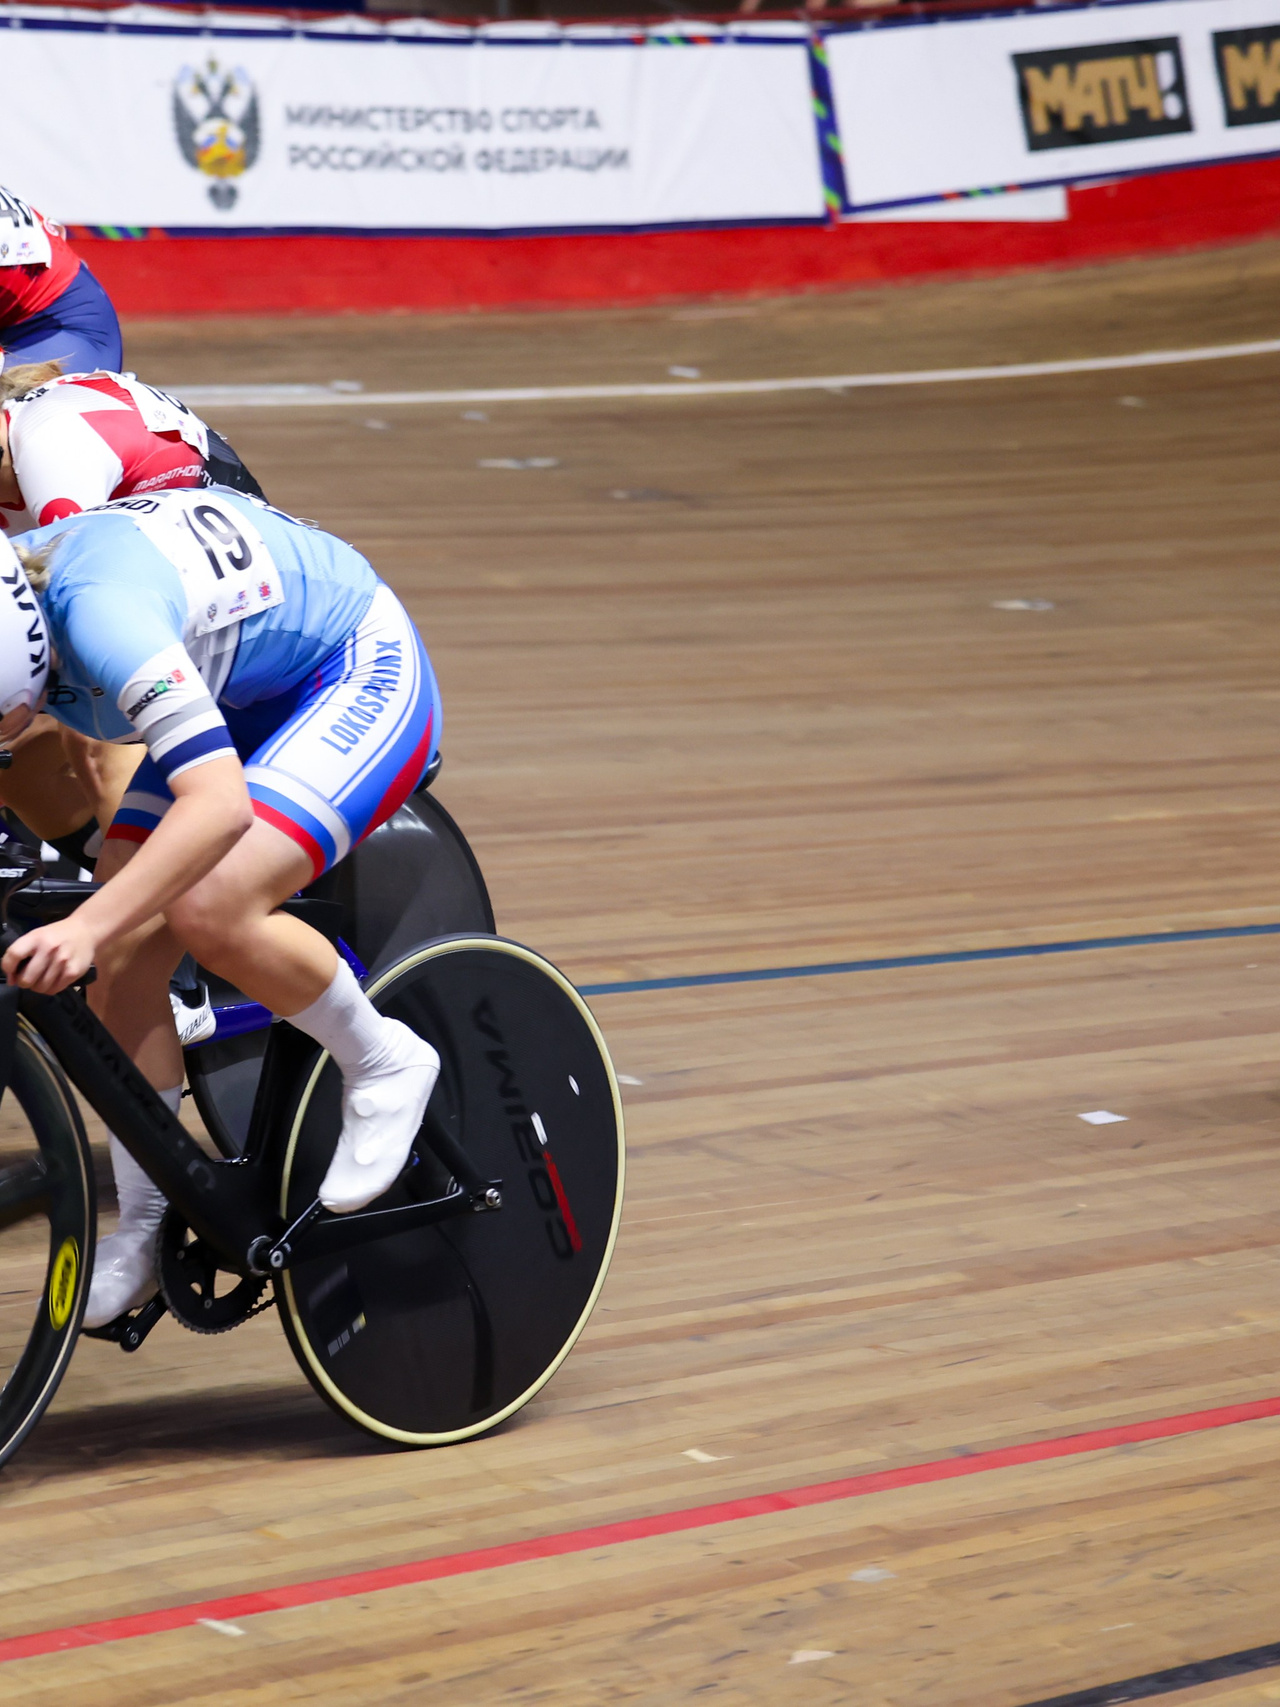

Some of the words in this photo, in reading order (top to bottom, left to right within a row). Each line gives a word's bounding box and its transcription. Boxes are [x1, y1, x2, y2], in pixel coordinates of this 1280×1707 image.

[285, 104, 493, 133] МИНИСТЕРСТВО
[504, 107, 601, 132] СПОРТА
[288, 140, 467, 172] РОССИЙСКОЙ
[475, 145, 630, 174] ФЕДЕРАЦИИ
[131, 465, 223, 493] MARATHON-TU
[182, 505, 253, 580] 19
